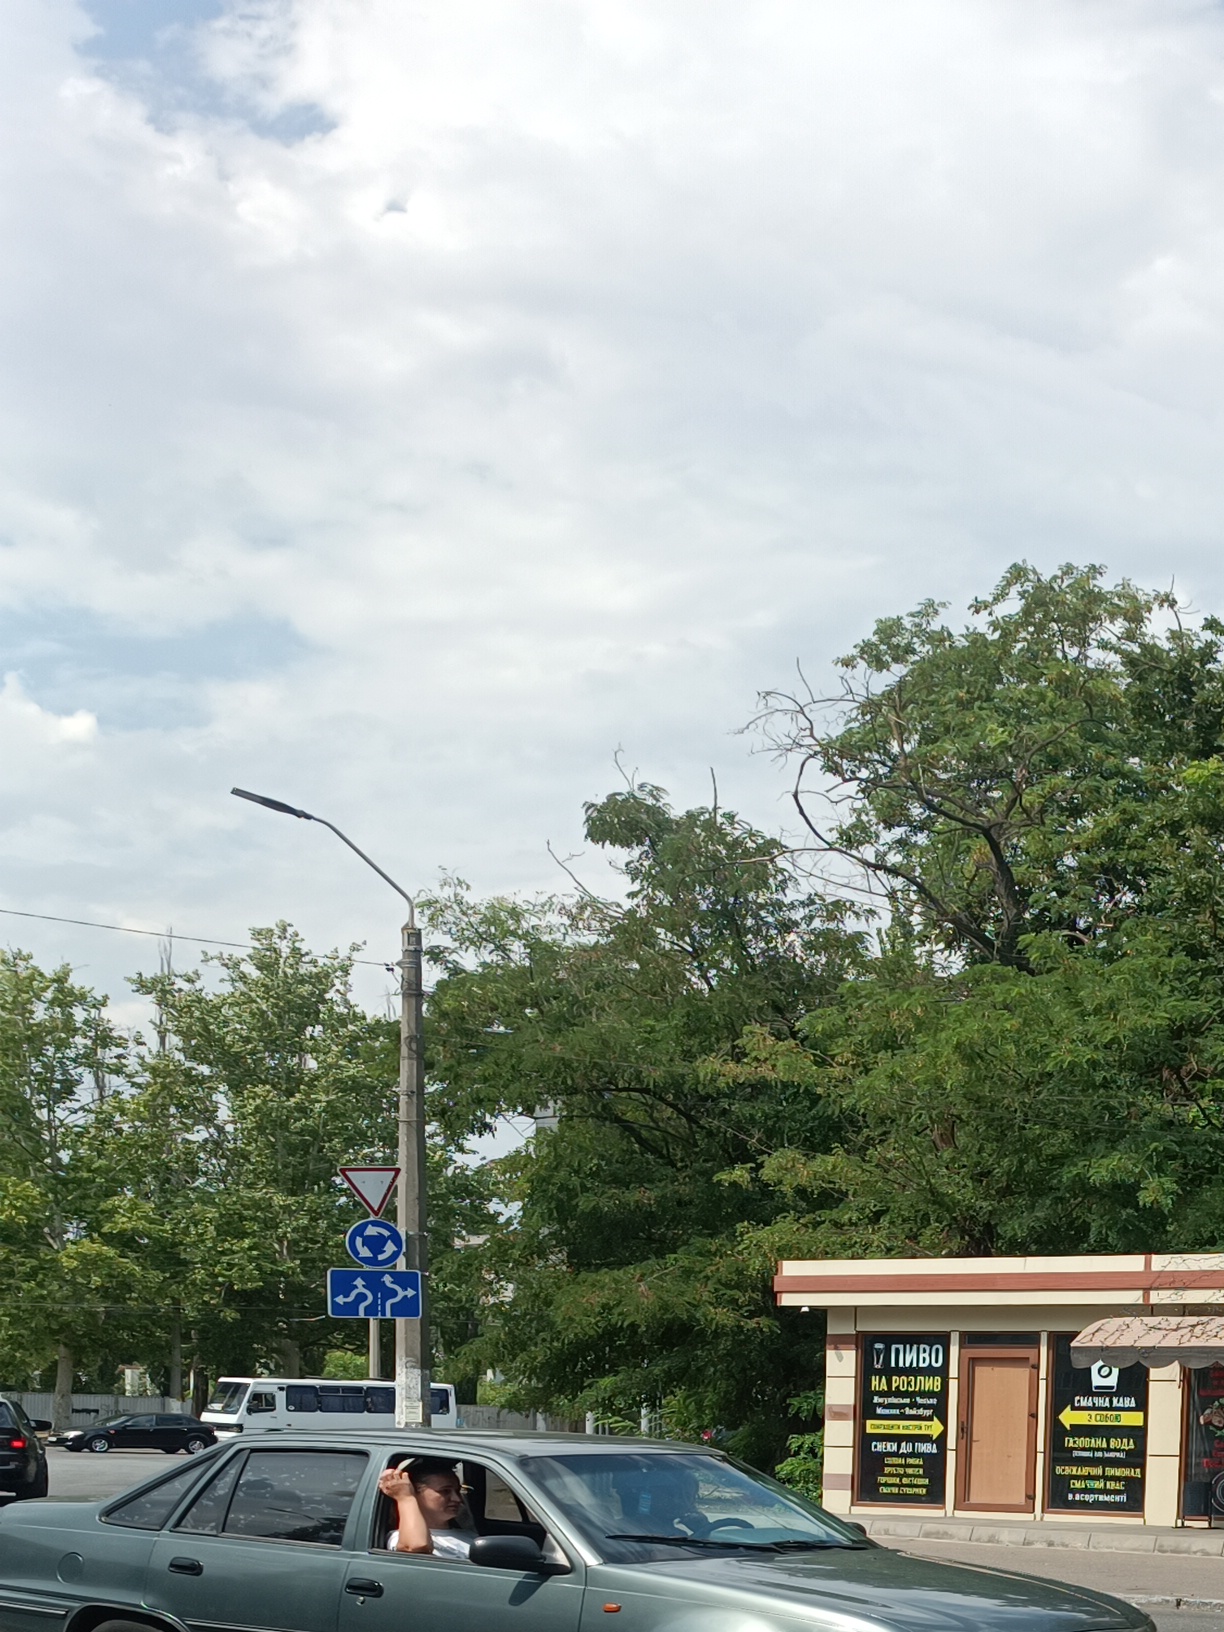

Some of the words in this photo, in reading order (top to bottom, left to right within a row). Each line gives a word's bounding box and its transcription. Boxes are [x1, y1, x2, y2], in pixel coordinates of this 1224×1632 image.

[890, 1343, 944, 1368] ПИВО
[871, 1375, 888, 1391] НА
[891, 1375, 942, 1392] РОЗЛИВ
[1074, 1395, 1110, 1408] СМАЧНА
[1112, 1396, 1136, 1408] КАВА
[1095, 1413, 1122, 1423] СОБОЮ
[871, 1441, 898, 1453] СНЕКИ
[899, 1441, 913, 1454] ДО
[914, 1442, 938, 1454] ПИВА
[1064, 1436, 1107, 1449] ГАЗОВАНА
[1109, 1437, 1135, 1450] ВОДА
[1104, 1467, 1142, 1478] ЛИМОНАД
[1106, 1480, 1126, 1490] КВАС
